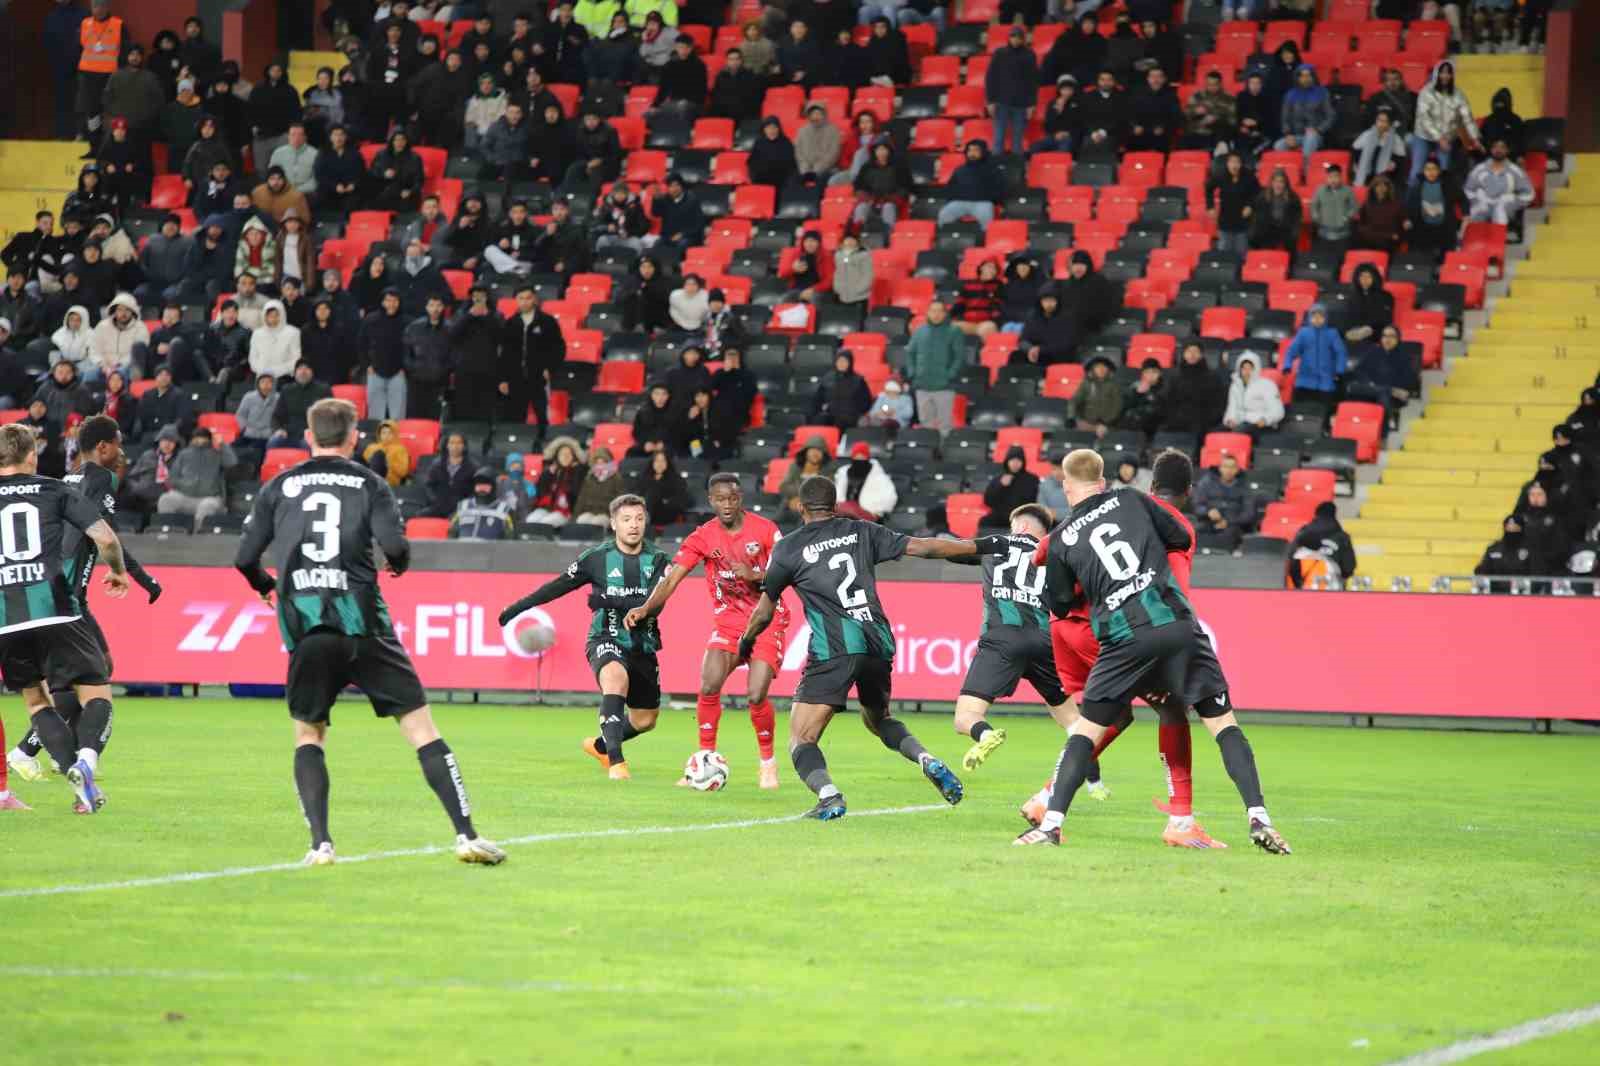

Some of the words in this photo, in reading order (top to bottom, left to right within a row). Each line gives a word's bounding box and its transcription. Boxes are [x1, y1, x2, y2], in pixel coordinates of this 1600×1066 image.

[293, 472, 366, 489] AUTOPORT
[302, 491, 342, 563] 3
[1067, 497, 1120, 536] AUTOPORT
[808, 533, 859, 555] AUTOPORT
[1089, 523, 1140, 581] 6
[828, 552, 868, 609] 2
